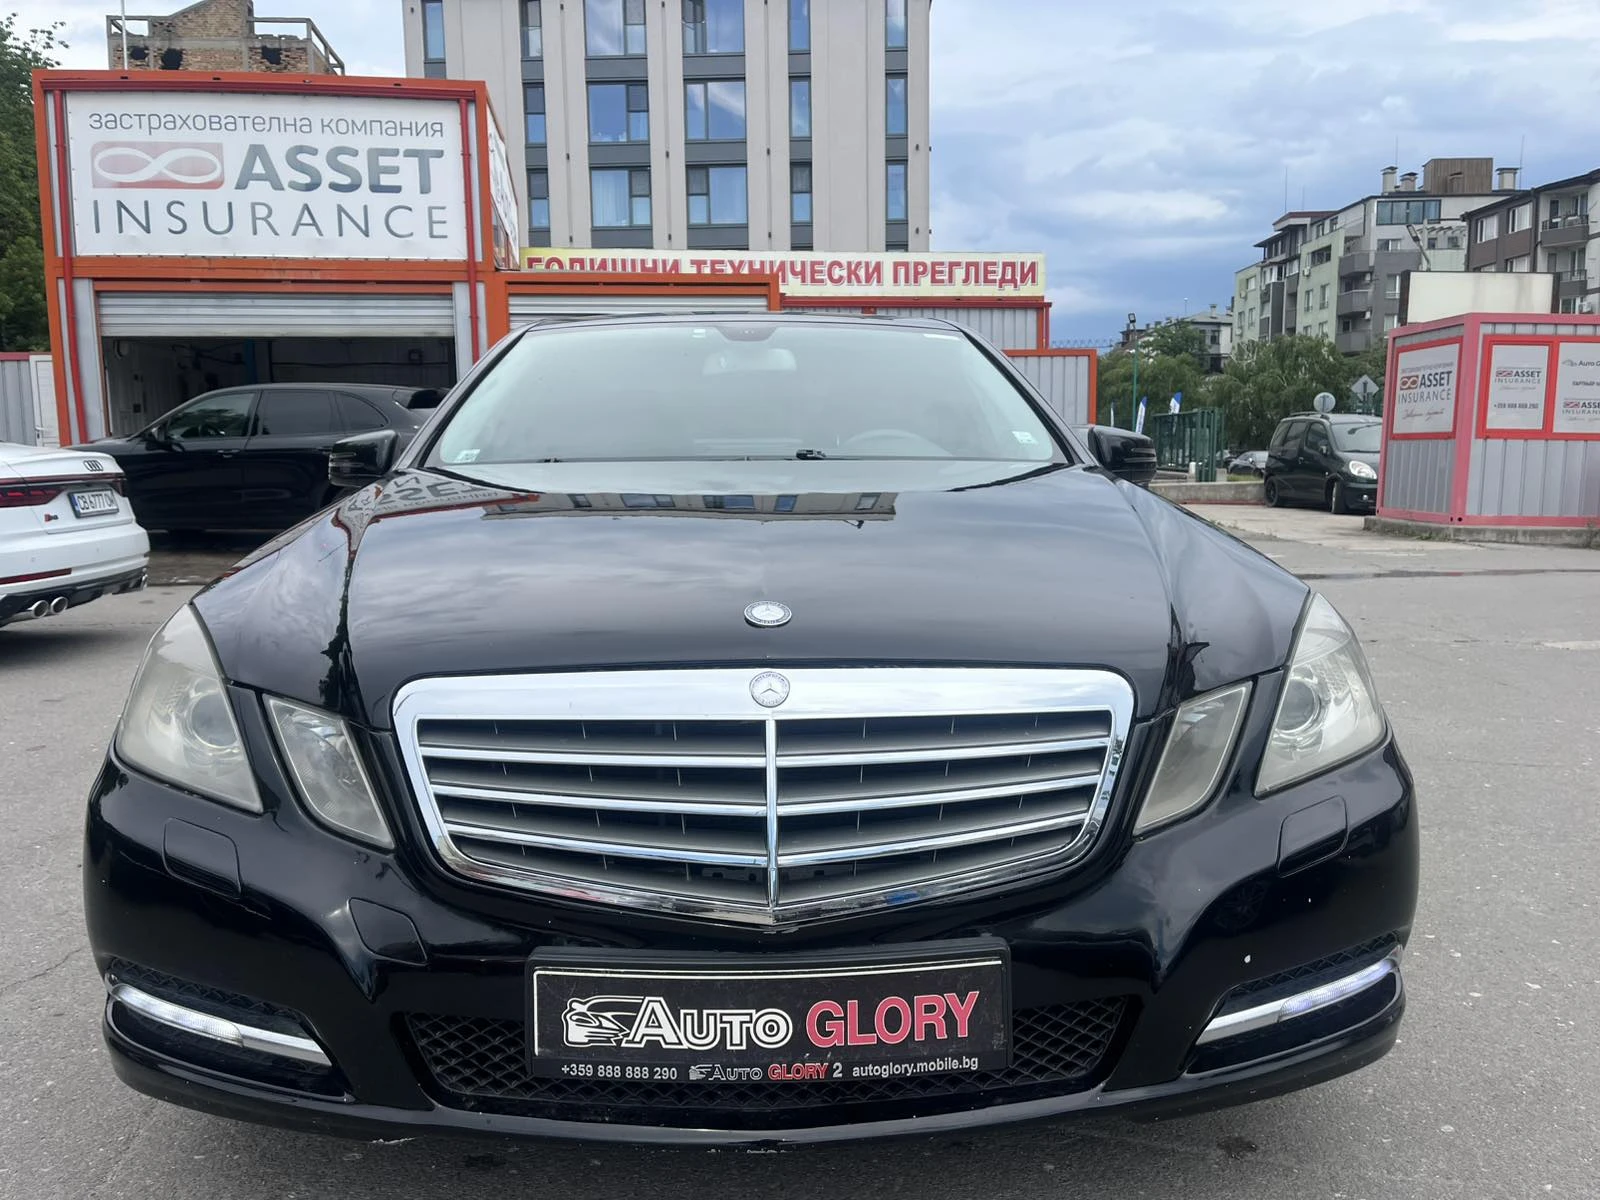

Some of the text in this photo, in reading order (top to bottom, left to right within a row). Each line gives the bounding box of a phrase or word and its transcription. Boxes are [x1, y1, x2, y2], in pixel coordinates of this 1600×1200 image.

[88, 112, 445, 138] застрахователна компания
[234, 143, 445, 195] ASSET
[91, 199, 449, 239] INSURANCE
[893, 260, 1038, 290] ПРЕГЛЕДИ
[1419, 370, 1453, 389] ASSET
[1513, 370, 1542, 378] ASSET
[1397, 387, 1452, 405] INSURANCE
[805, 990, 980, 1047] GLORY
[561, 1063, 593, 1077] +359
[597, 1065, 622, 1078] 888
[625, 1066, 650, 1080] 888
[653, 1067, 678, 1080] 290
[767, 1062, 829, 1080] GLORY
[832, 1062, 843, 1078] 2
[852, 1055, 979, 1078] autoglory.mobile.bg
